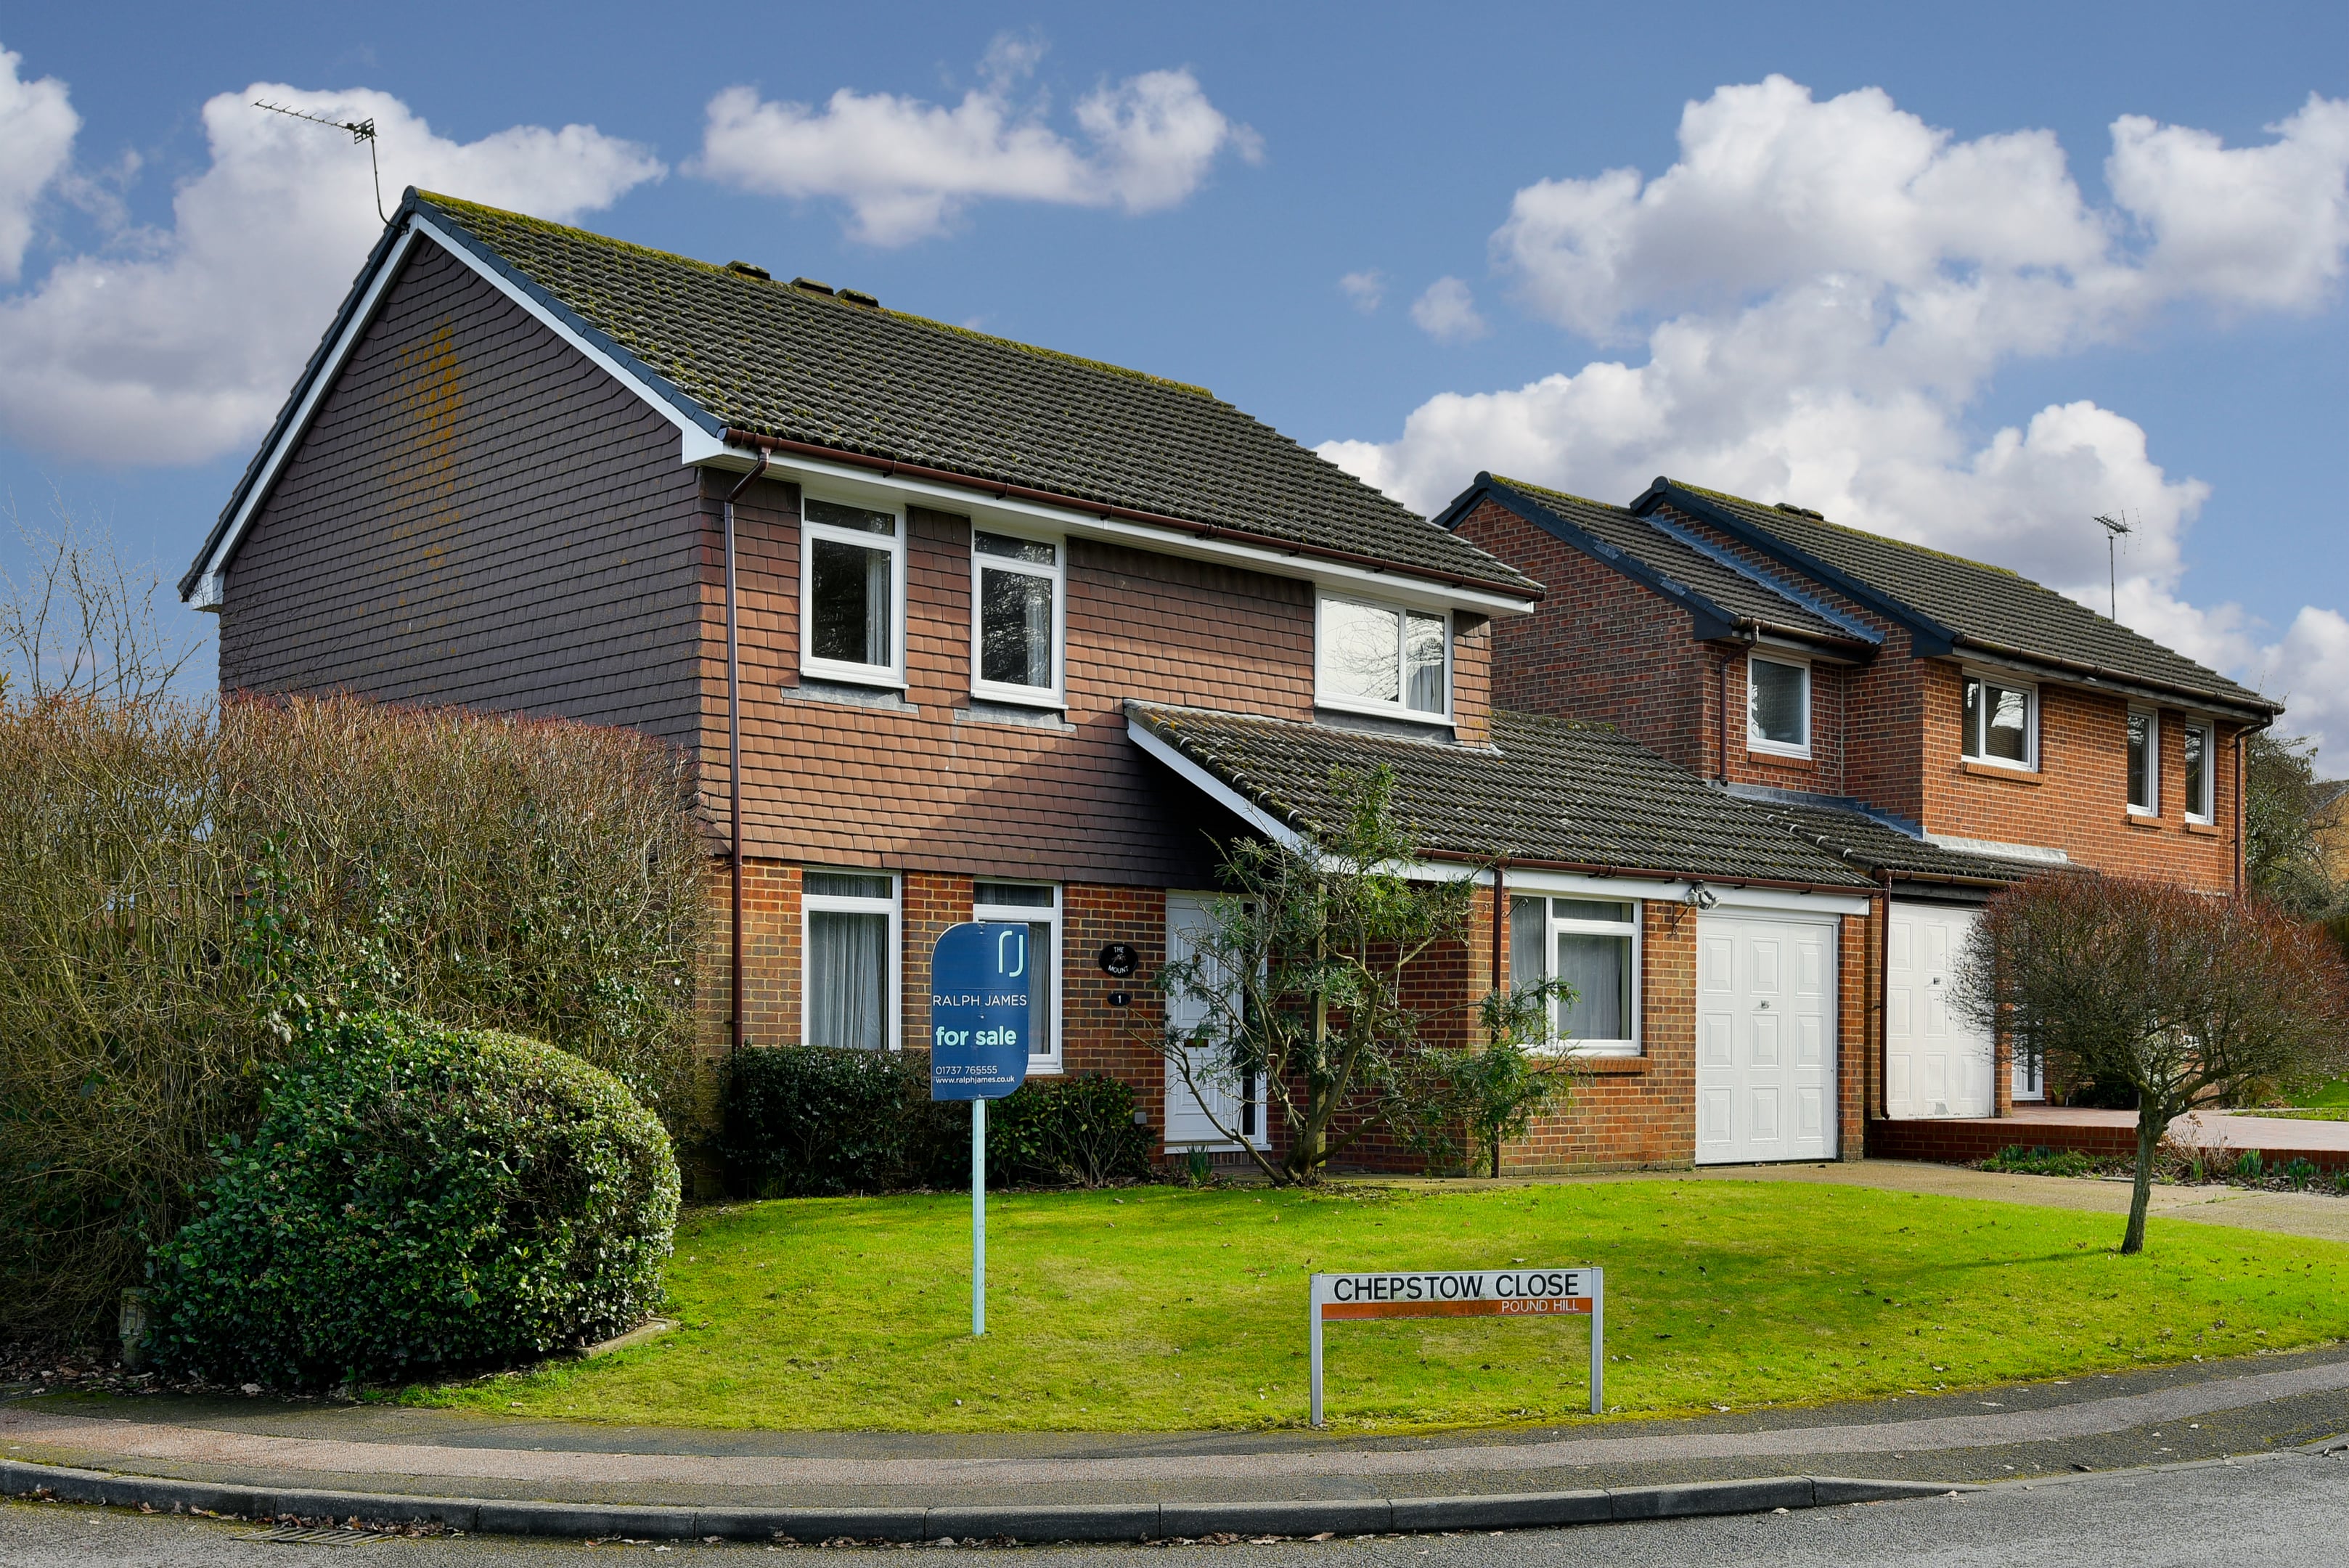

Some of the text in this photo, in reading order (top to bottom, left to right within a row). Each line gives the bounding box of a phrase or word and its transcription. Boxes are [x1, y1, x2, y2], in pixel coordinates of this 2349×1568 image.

[1108, 965, 1129, 973] MOUNT
[933, 995, 1027, 1006] RALPH JAMES
[1118, 995, 1122, 1004] 1
[936, 1026, 1016, 1046] for sale
[936, 1066, 997, 1075] 01737 765555
[936, 1076, 1015, 1085] www.ralphjames.co.uk
[1333, 1273, 1579, 1302] CHEPSTOW CLOSE
[1502, 1299, 1579, 1312] POUND HILL
